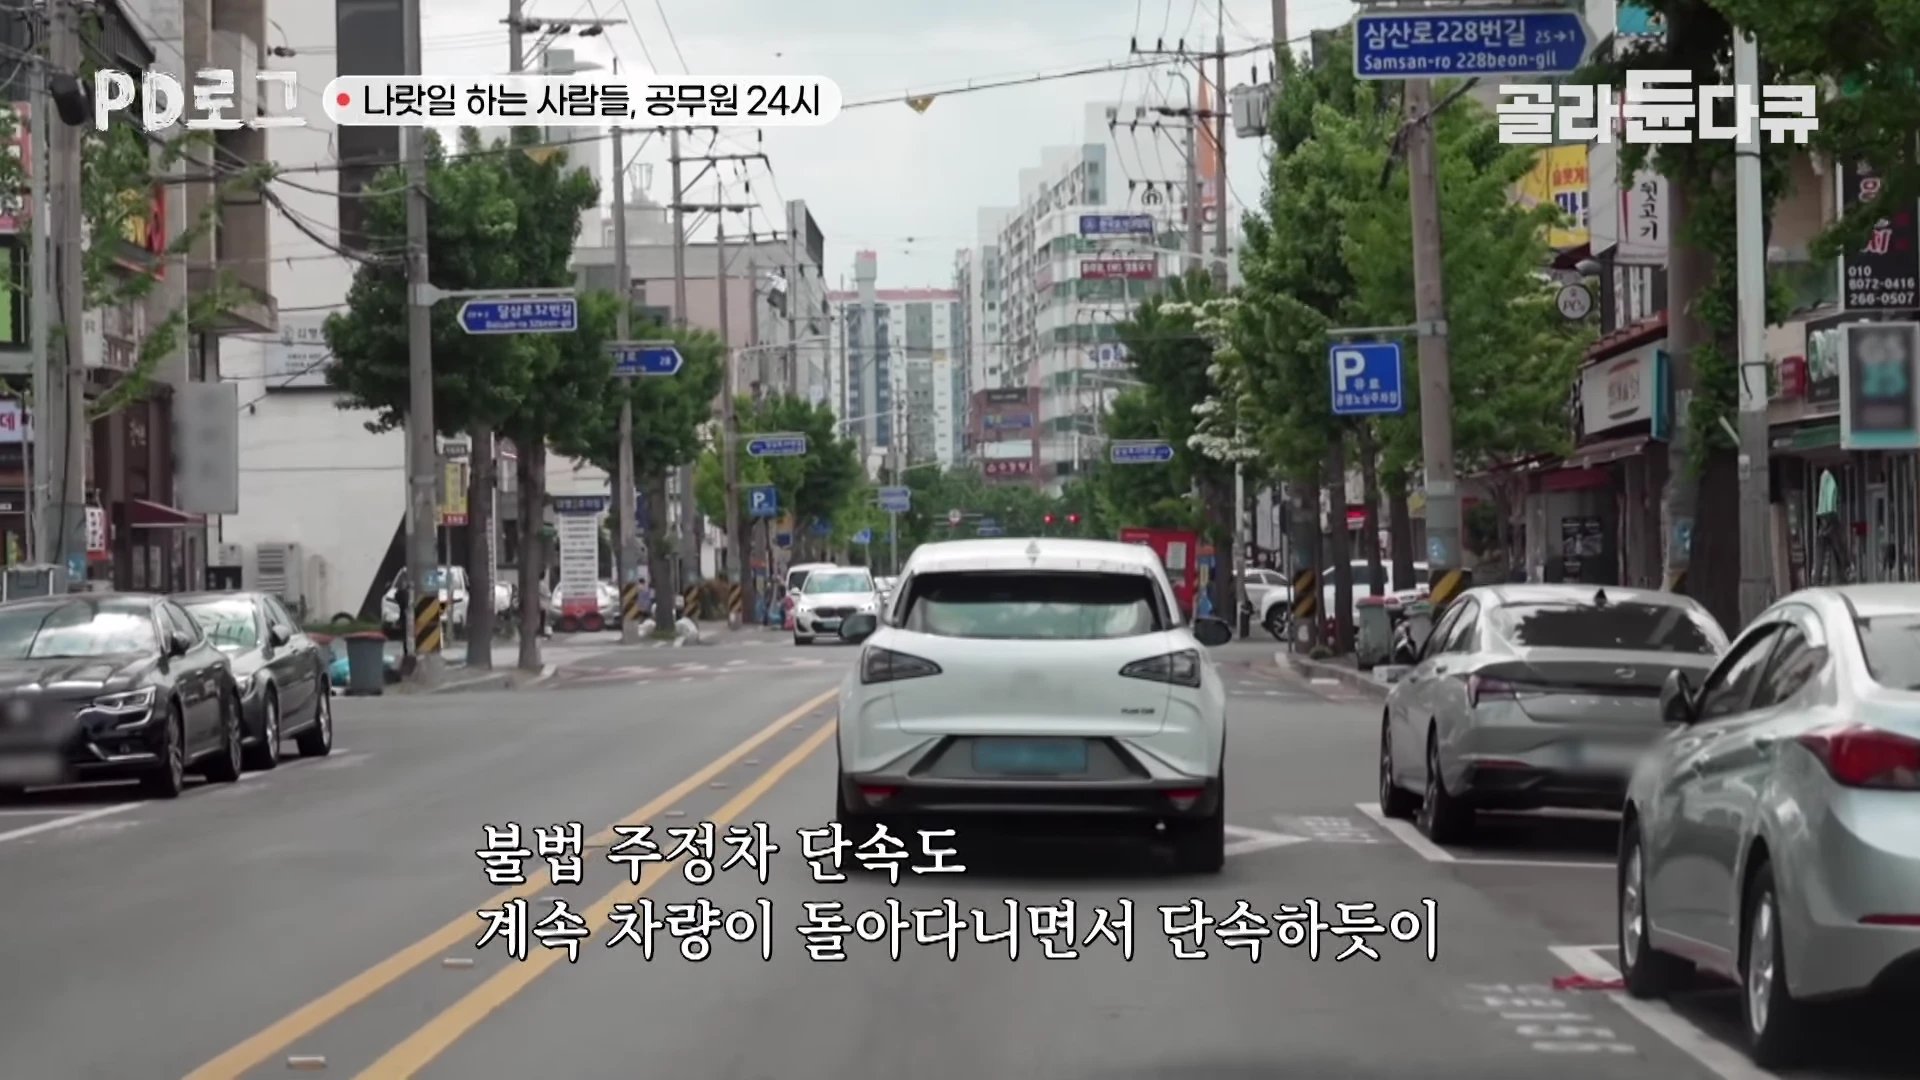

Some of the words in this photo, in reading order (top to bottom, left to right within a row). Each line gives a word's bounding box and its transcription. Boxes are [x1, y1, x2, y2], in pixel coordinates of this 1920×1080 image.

[1364, 54, 1451, 71] Samsan-ro
[1456, 51, 1557, 71] 228beon-gil
[1848, 265, 1872, 277] 010
[1848, 277, 1915, 291] 8072-0416
[1335, 351, 1366, 392] P
